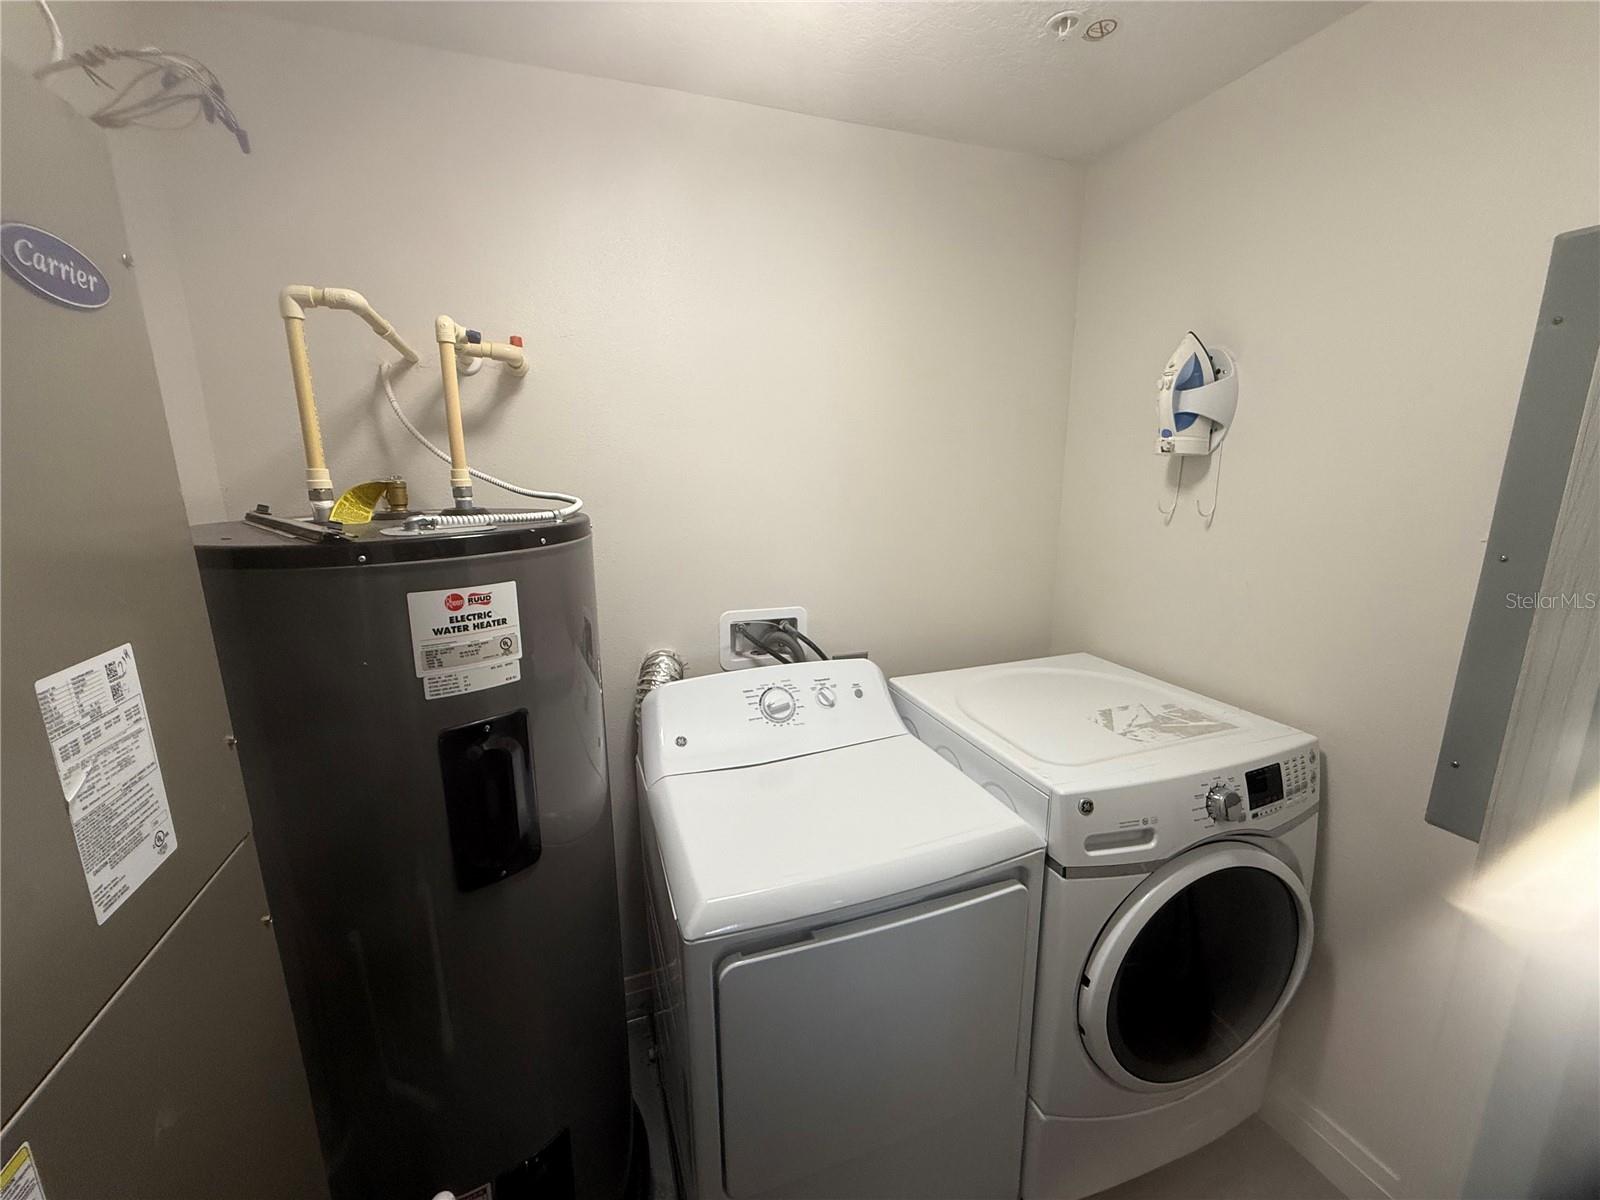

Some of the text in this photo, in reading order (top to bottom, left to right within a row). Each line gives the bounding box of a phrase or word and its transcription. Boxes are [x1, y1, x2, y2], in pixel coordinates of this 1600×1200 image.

[14, 239, 98, 292] Carrier
[467, 595, 492, 604] RUUD
[449, 611, 493, 624] ELECTRIC
[432, 617, 508, 636] WATER HEATER
